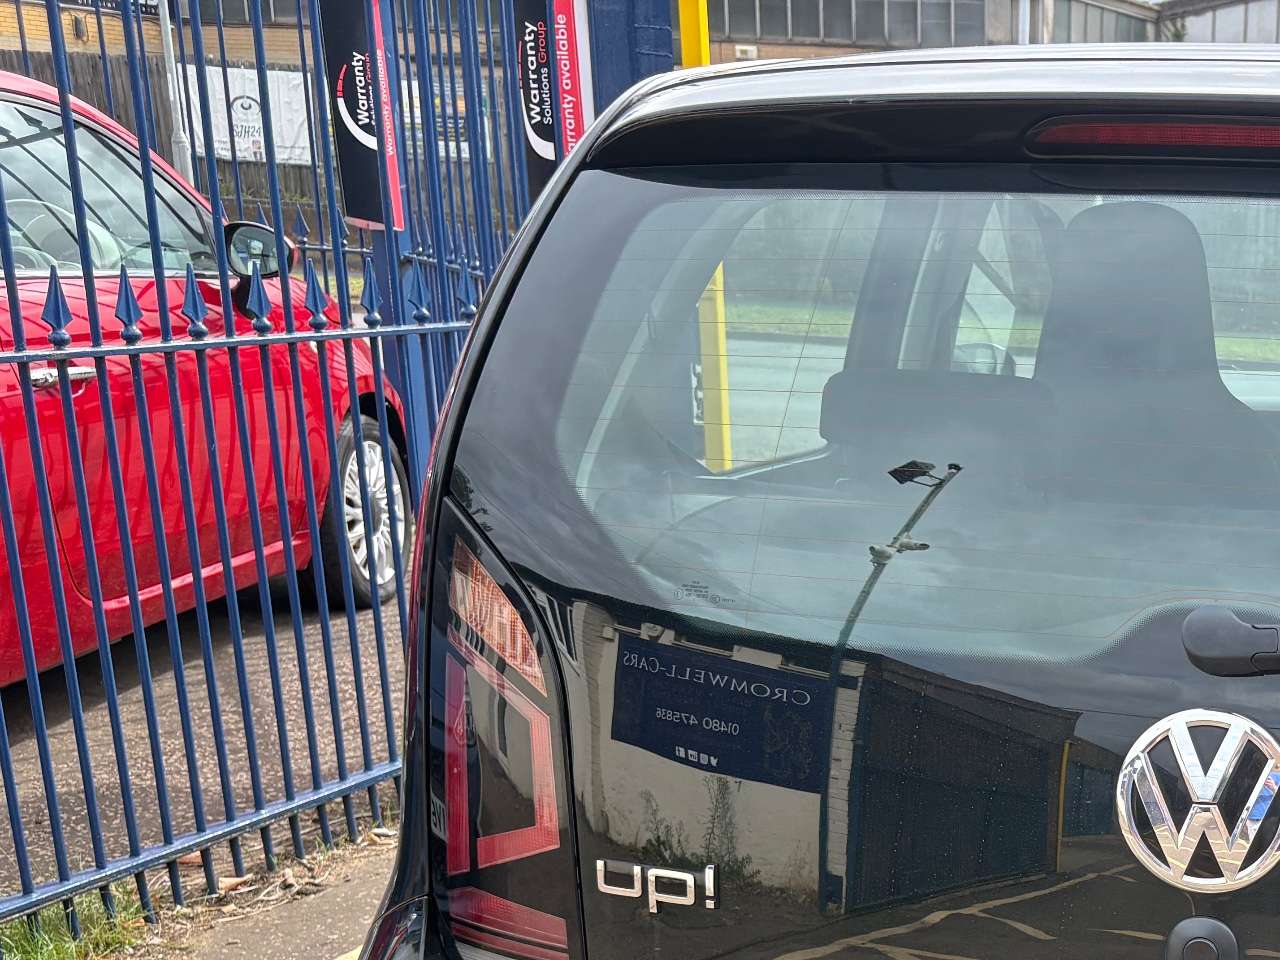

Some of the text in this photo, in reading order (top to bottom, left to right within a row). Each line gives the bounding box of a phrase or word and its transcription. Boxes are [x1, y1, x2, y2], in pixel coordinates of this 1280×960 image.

[352, 51, 370, 125] Warranty
[524, 21, 541, 125] Warranty
[538, 21, 552, 125] Solutions Group
[554, 14, 576, 156] arranty available
[382, 103, 394, 156] Warranty
[596, 859, 715, 914] up!
